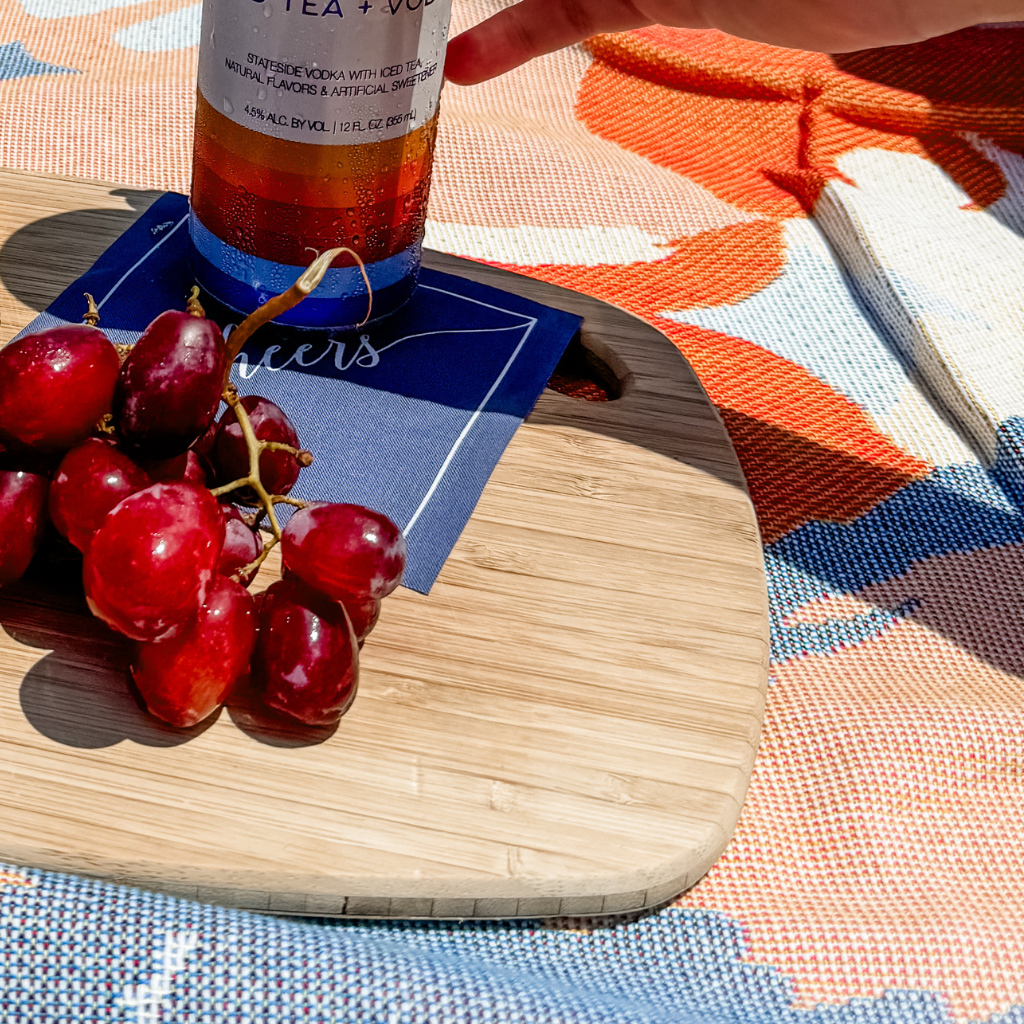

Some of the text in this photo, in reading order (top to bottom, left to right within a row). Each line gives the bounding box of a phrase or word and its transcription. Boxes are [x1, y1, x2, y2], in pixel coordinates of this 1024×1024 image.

[225, 57, 265, 85] NATURAL
[266, 77, 318, 96] FLAVORS
[320, 86, 328, 97] &
[330, 83, 389, 97] ARTIFICIAL
[247, 53, 303, 78] STATESIDE
[304, 67, 346, 81] VODKA
[348, 69, 377, 81] WITH
[380, 64, 404, 78] ICED
[266, 113, 289, 127] ALC.
[291, 117, 307, 130] BY
[339, 122, 351, 132] 12
